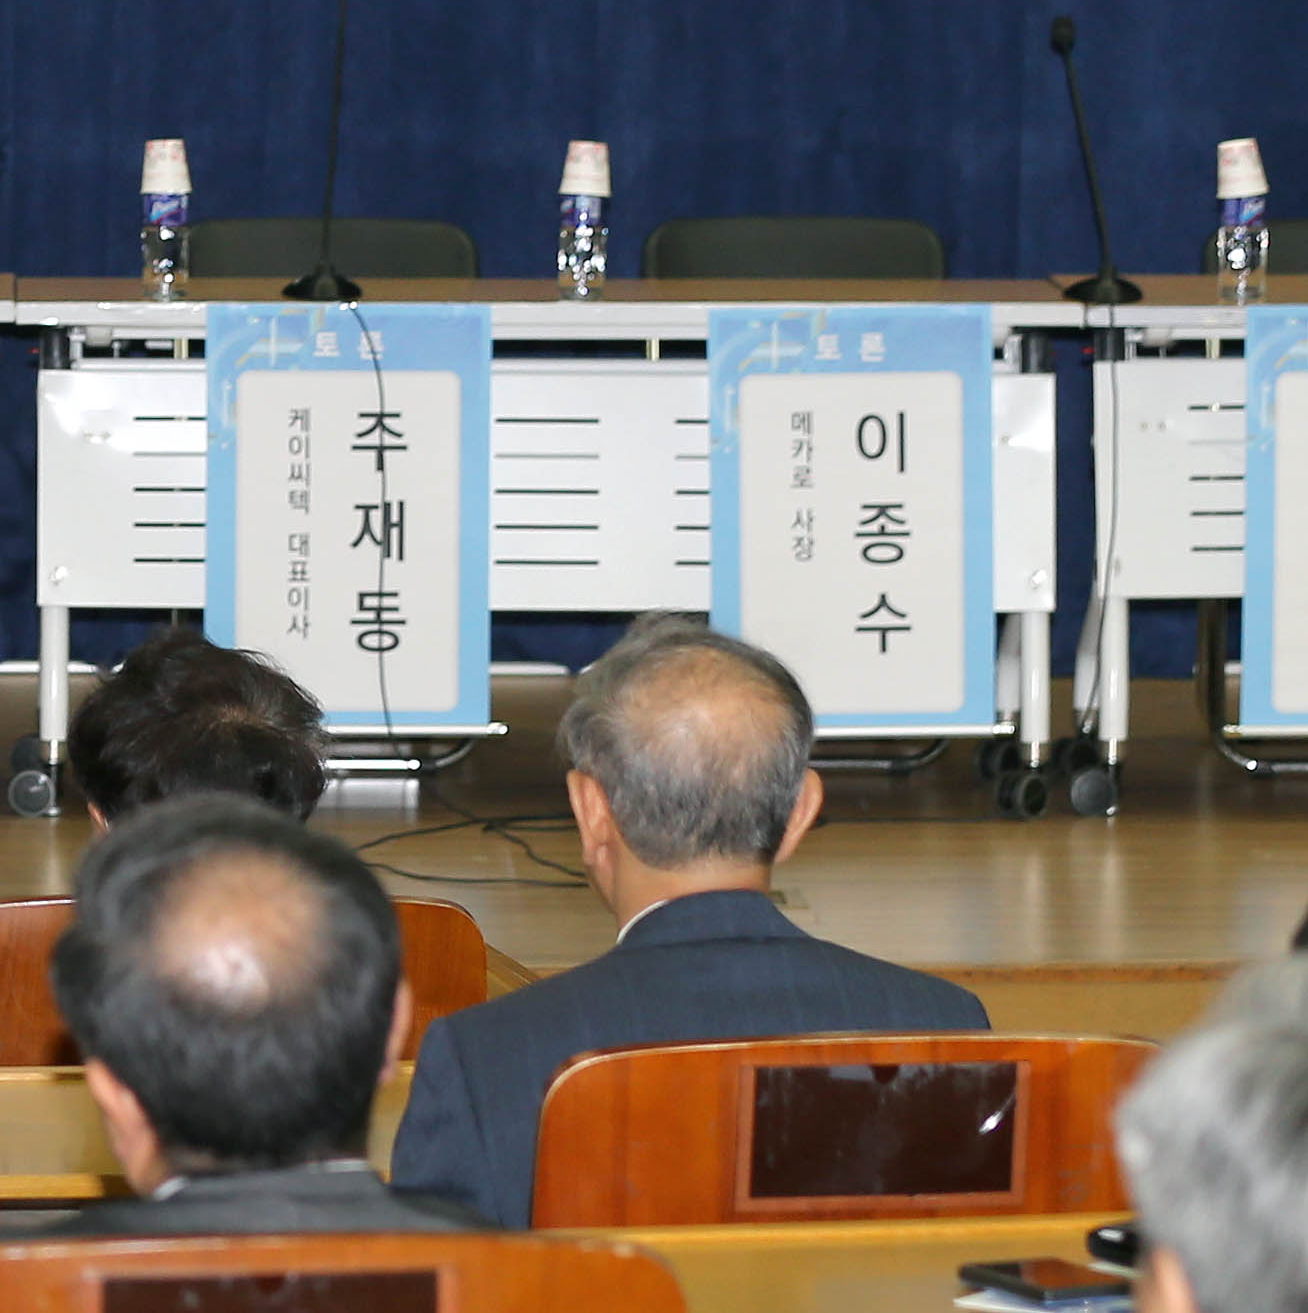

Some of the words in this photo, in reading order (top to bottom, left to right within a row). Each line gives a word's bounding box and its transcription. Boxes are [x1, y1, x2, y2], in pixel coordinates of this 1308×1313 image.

[814, 333, 886, 363] 토론
[288, 407, 311, 515] 케이씨텍
[350, 410, 409, 654] 주재동
[791, 508, 816, 562] 사장
[854, 411, 912, 654] 이종수
[287, 533, 310, 640] 대표이사
